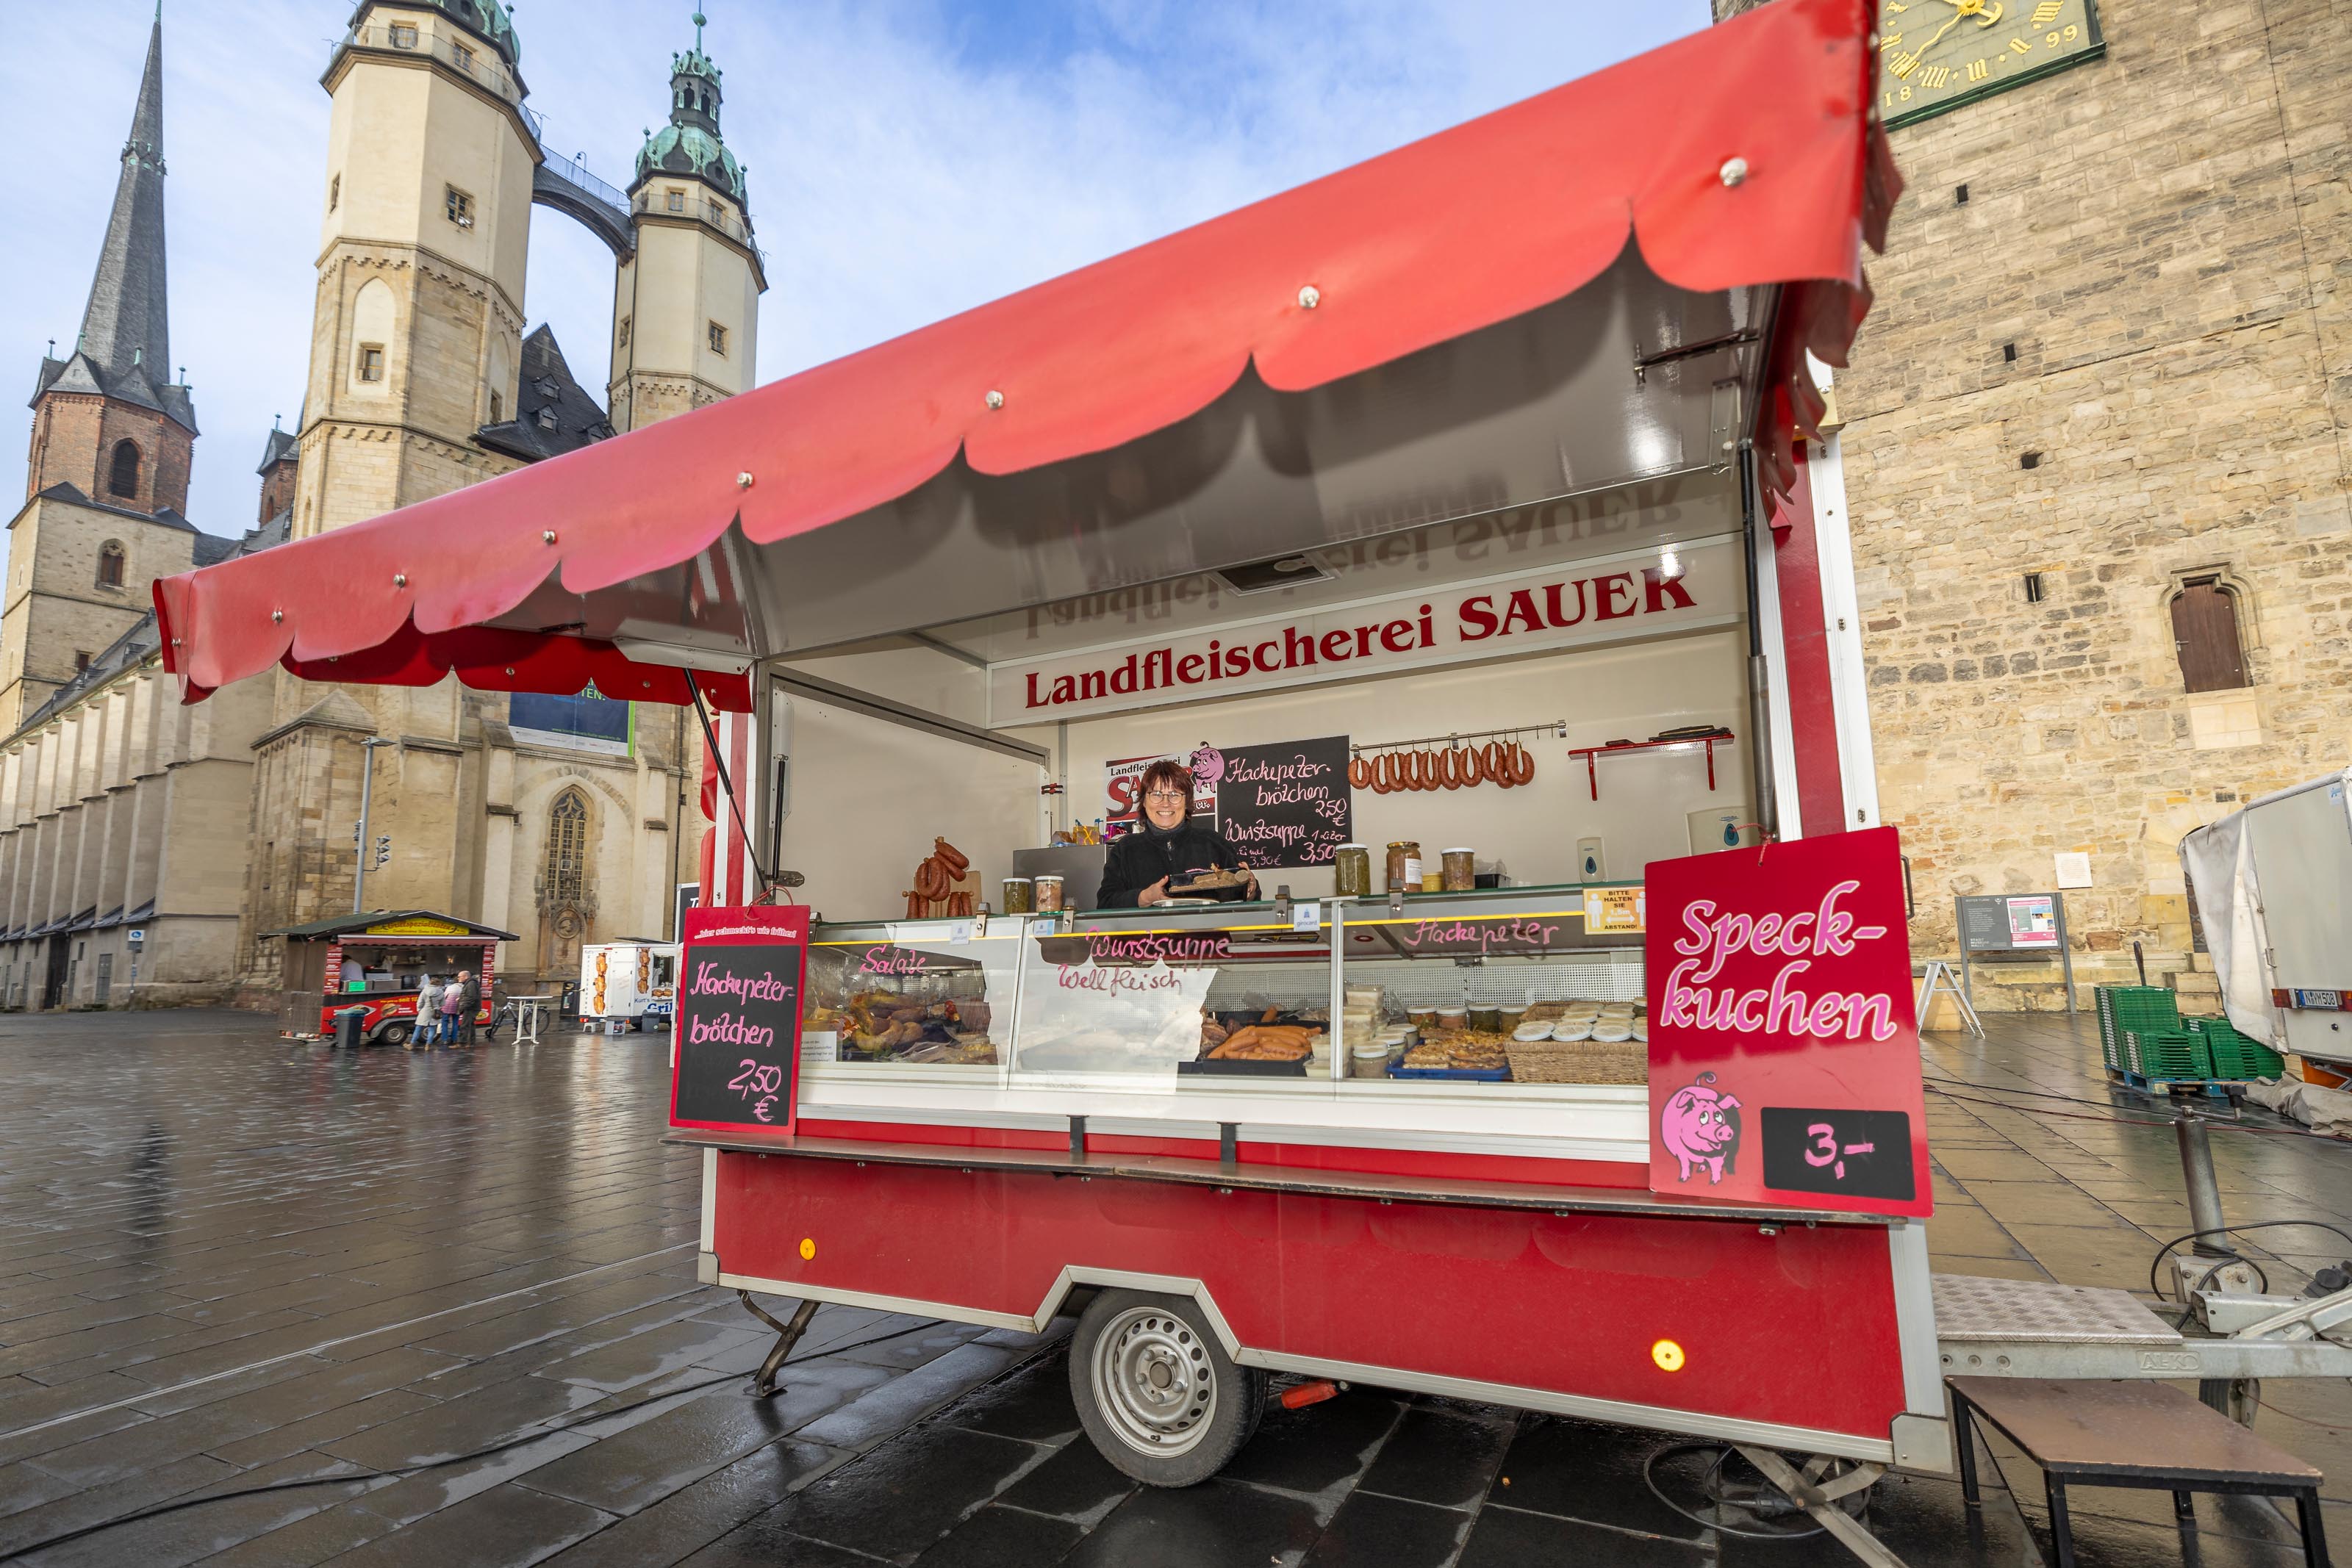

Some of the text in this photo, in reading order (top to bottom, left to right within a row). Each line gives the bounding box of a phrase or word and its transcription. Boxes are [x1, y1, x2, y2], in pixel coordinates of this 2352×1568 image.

[1025, 565, 1697, 710] Landfleischerei SAUER
[1315, 798, 1347, 818] 2,50
[1332, 813, 1346, 827] €
[1225, 817, 1308, 848] Wurstsuppe
[756, 926, 770, 935] wie
[1297, 920, 1317, 928] girocard
[1674, 880, 1888, 983] Speck-
[858, 943, 926, 974] Salate
[647, 1001, 673, 1013] Gril
[1660, 958, 1898, 1042] kuchen
[2322, 993, 2336, 1005] 508
[689, 1013, 774, 1047] brötchen
[727, 1059, 782, 1101] 2,50
[753, 1096, 779, 1123] €
